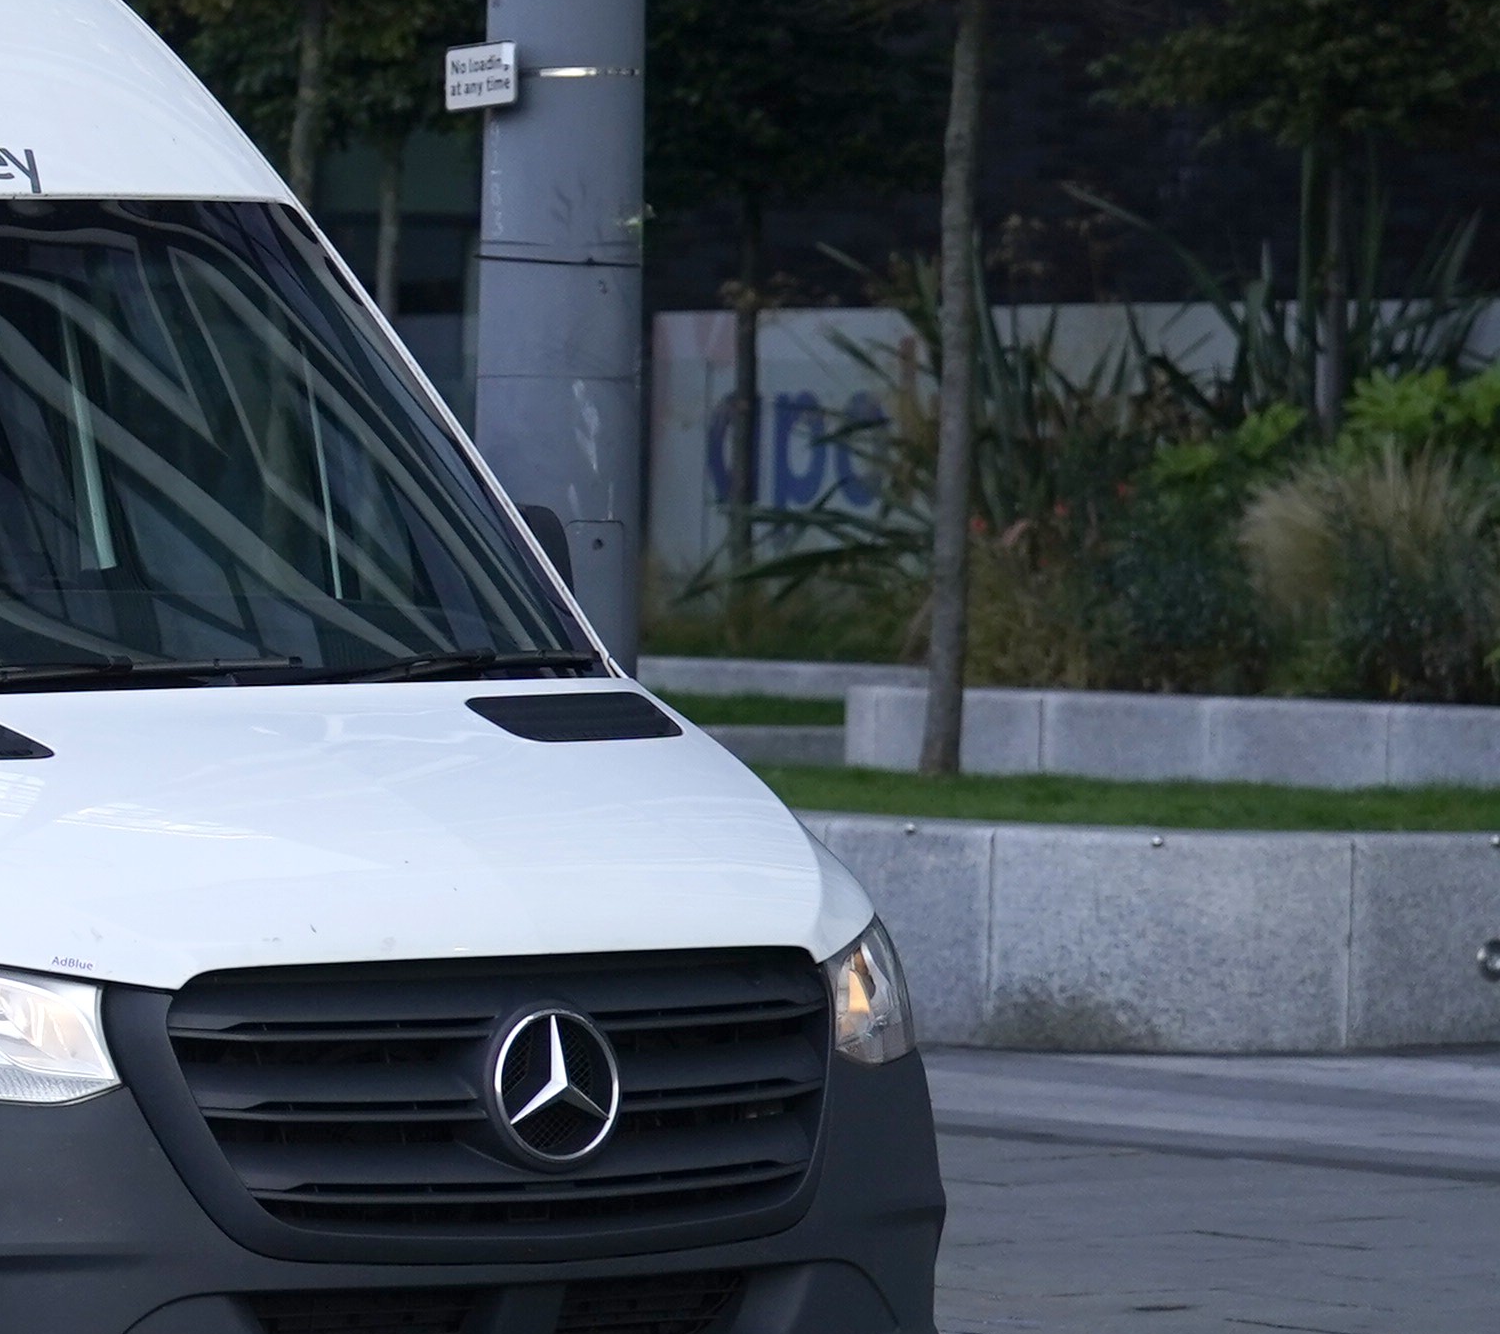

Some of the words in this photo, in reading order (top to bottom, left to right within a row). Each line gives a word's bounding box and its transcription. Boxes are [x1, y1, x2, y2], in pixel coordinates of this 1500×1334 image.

[450, 60, 466, 75] No
[450, 82, 462, 96] at
[51, 956, 94, 971] AdBlue
